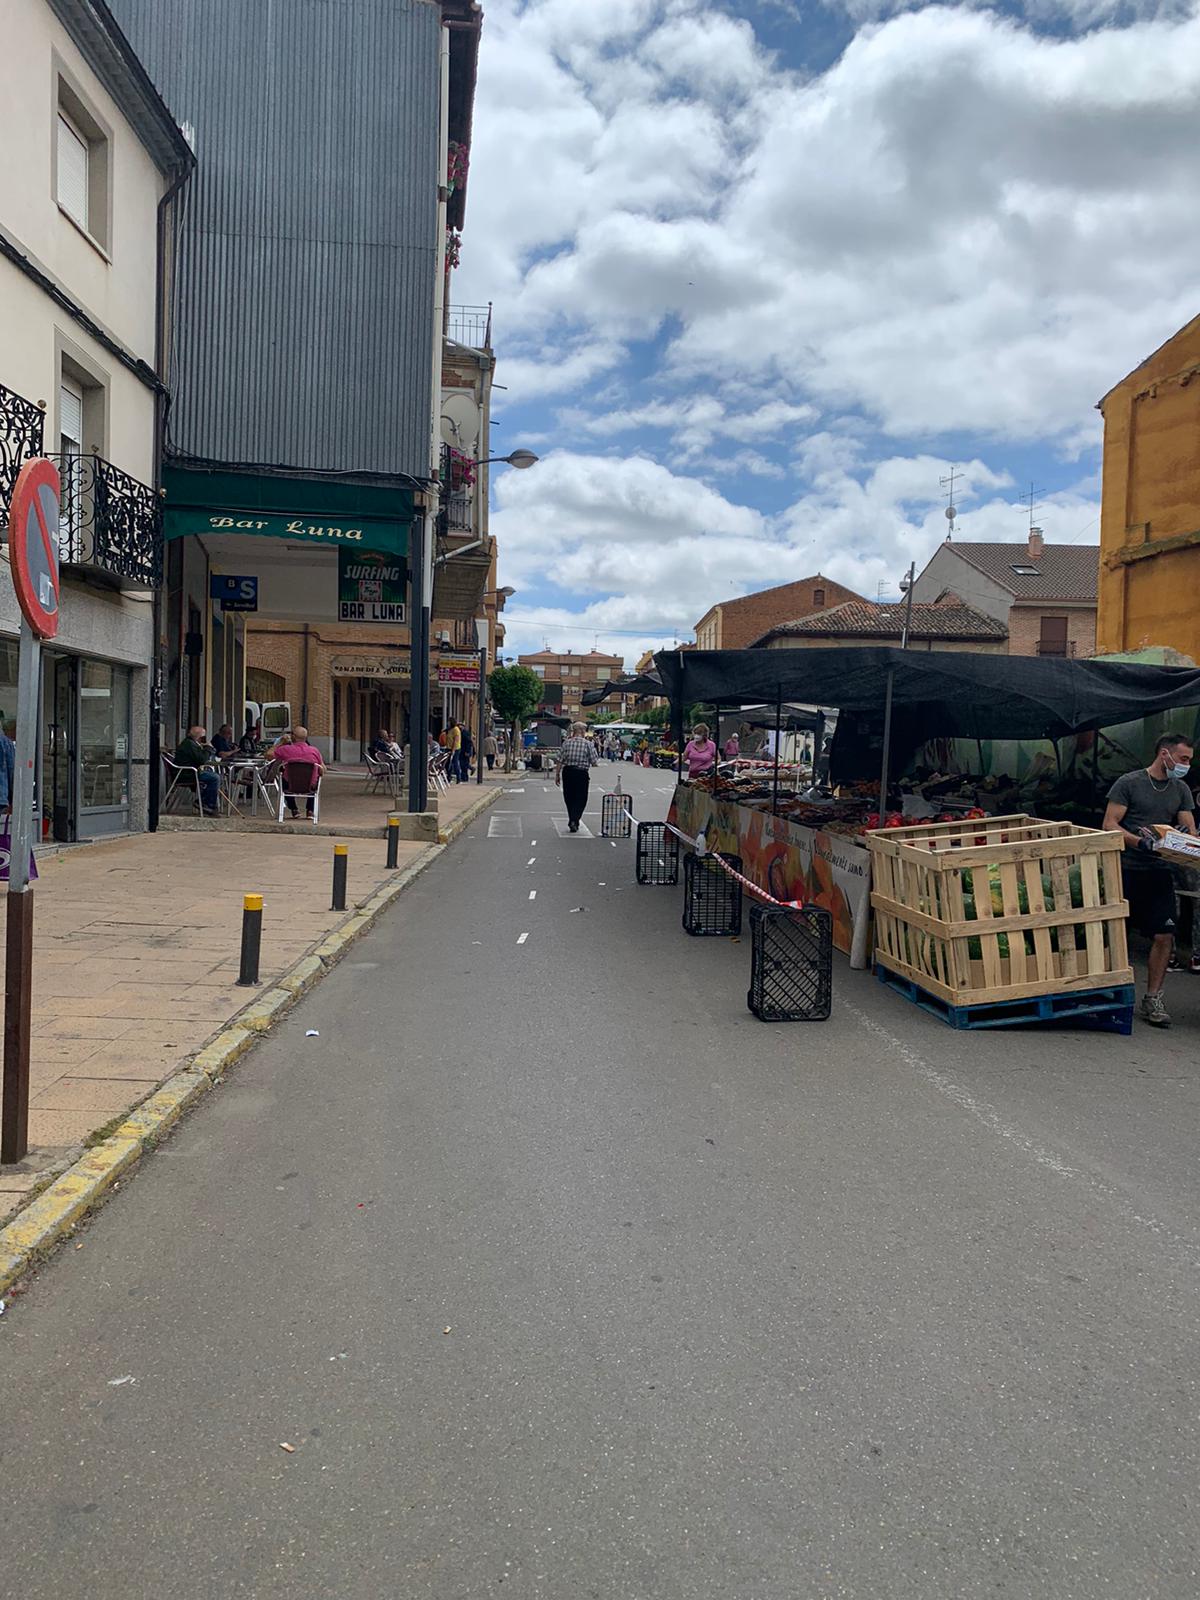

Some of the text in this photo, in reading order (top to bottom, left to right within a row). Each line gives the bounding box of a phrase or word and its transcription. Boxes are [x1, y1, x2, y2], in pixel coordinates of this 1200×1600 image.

[209, 516, 363, 540] Bar Luna
[344, 565, 400, 581] SURFING
[240, 580, 256, 600] S
[341, 602, 404, 621] BAR LUNA
